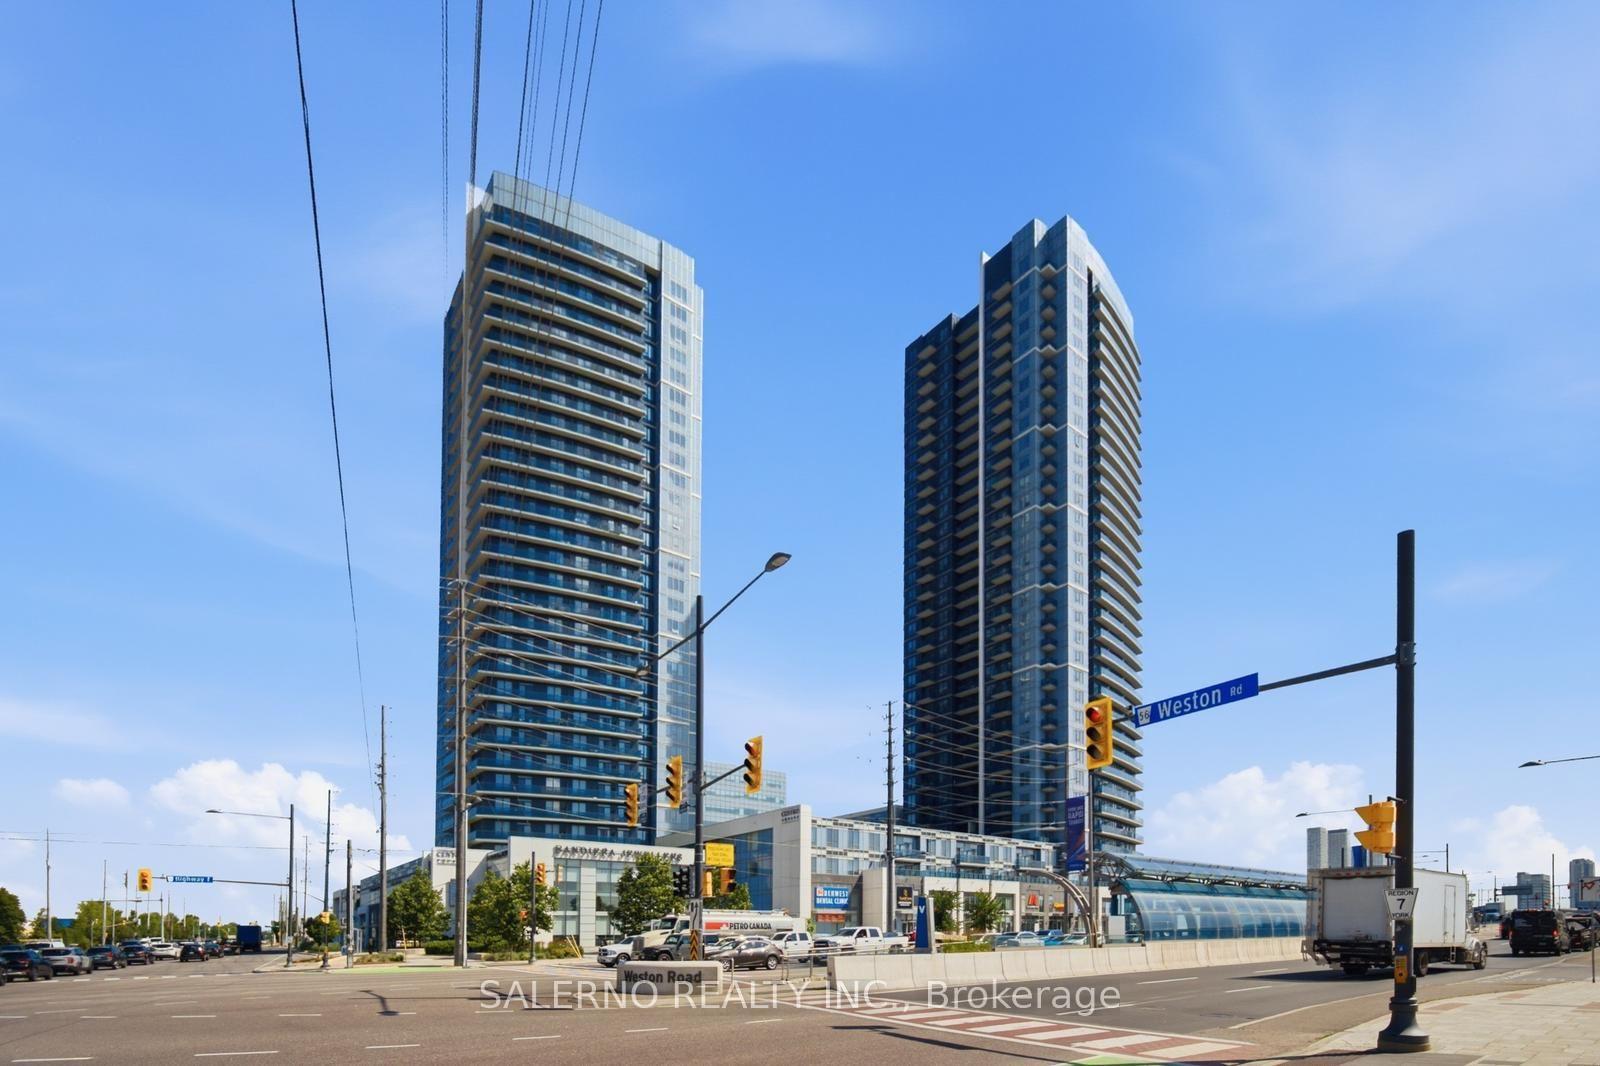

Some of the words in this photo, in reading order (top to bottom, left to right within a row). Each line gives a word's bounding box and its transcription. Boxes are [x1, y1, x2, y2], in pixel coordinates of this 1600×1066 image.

[1139, 710, 1150, 721] 56
[1158, 688, 1221, 719] Weston
[1230, 684, 1243, 697] Rd
[1388, 889, 1414, 897] REGION
[1396, 898, 1406, 910] 7
[624, 970, 663, 983] Weston
[667, 970, 702, 983] Road
